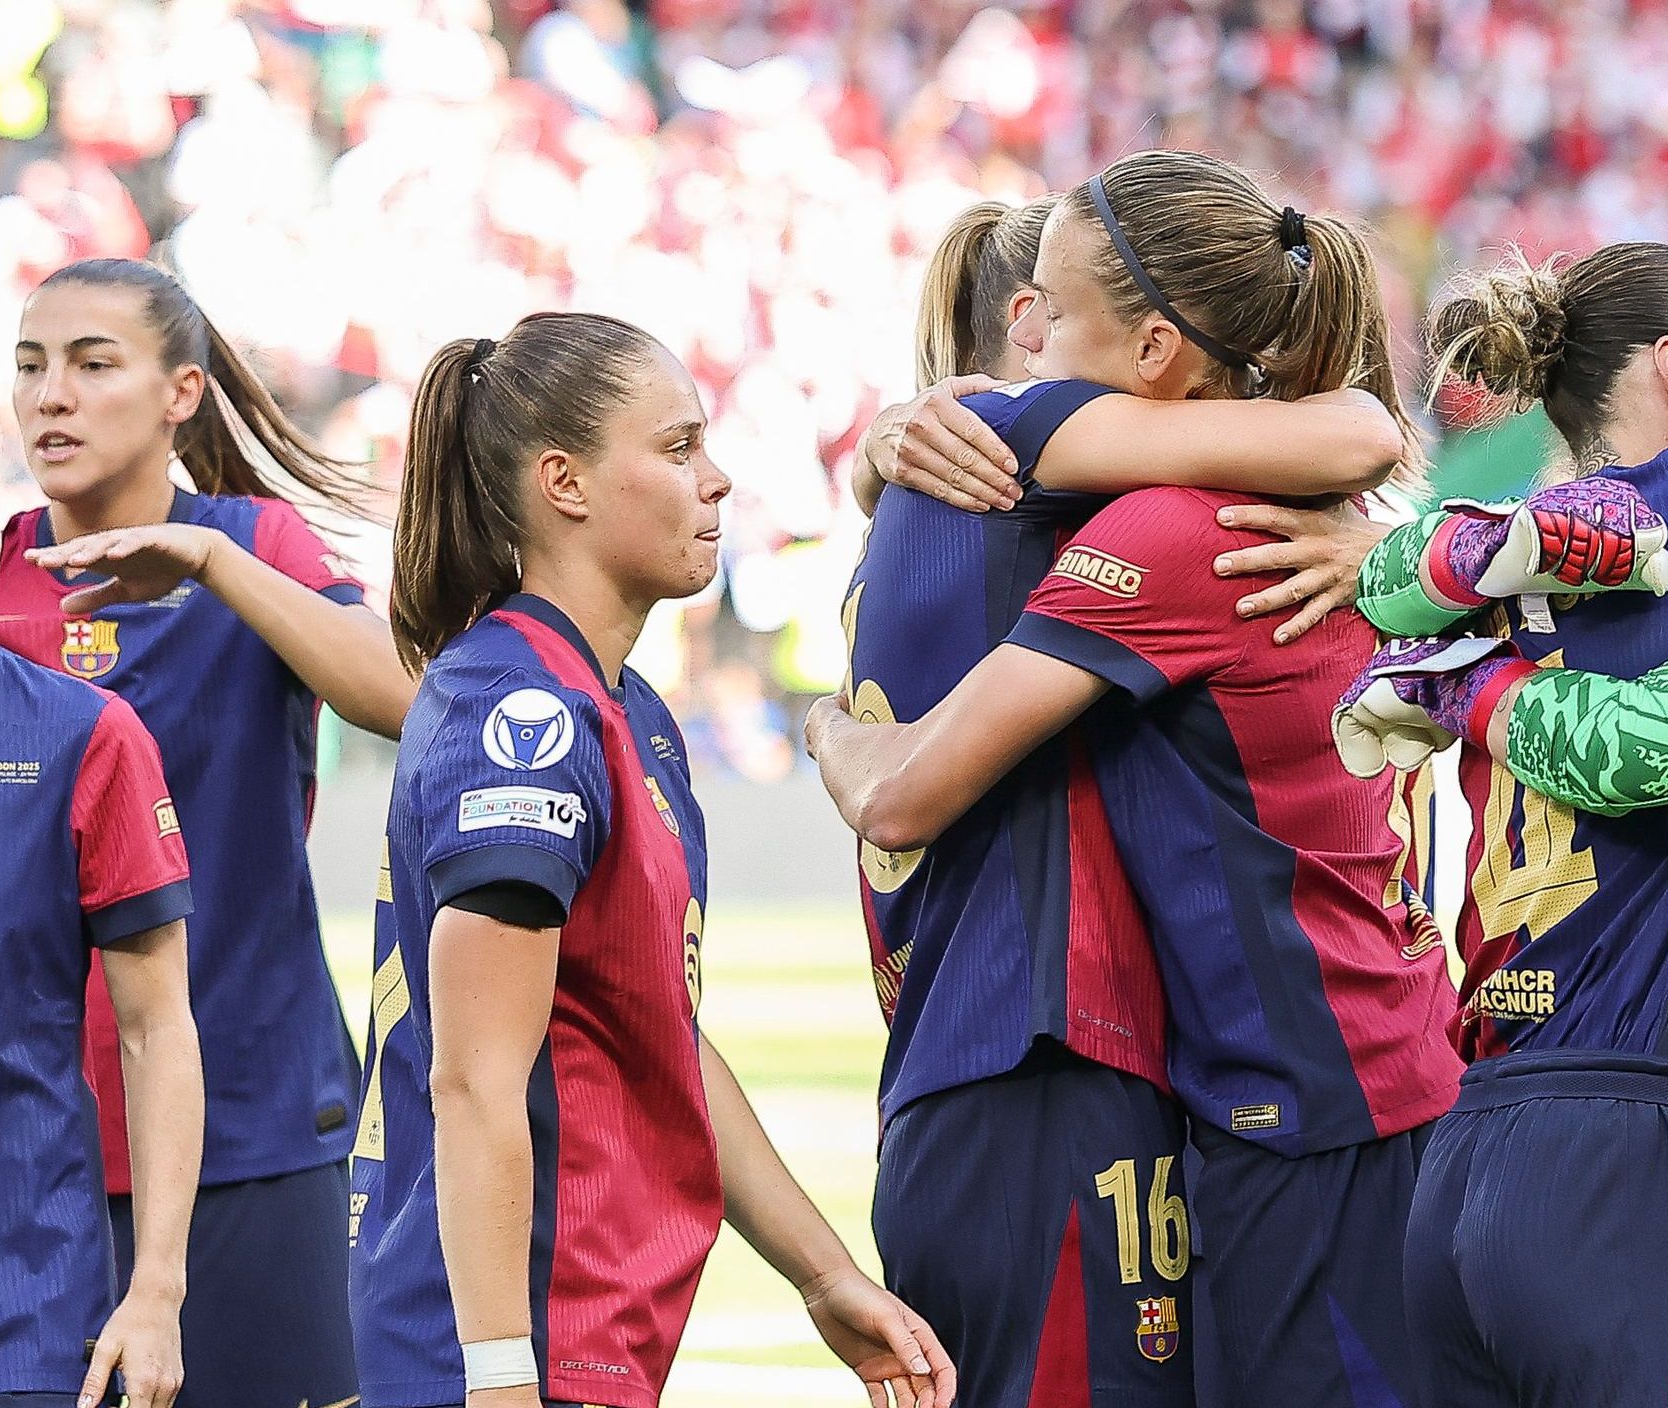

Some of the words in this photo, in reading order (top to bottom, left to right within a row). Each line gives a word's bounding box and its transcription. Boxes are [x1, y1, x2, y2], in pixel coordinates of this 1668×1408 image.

[1054, 551, 1142, 593] BIMBO
[463, 801, 543, 817] FOUNDATION
[1094, 1155, 1190, 1285] 16
